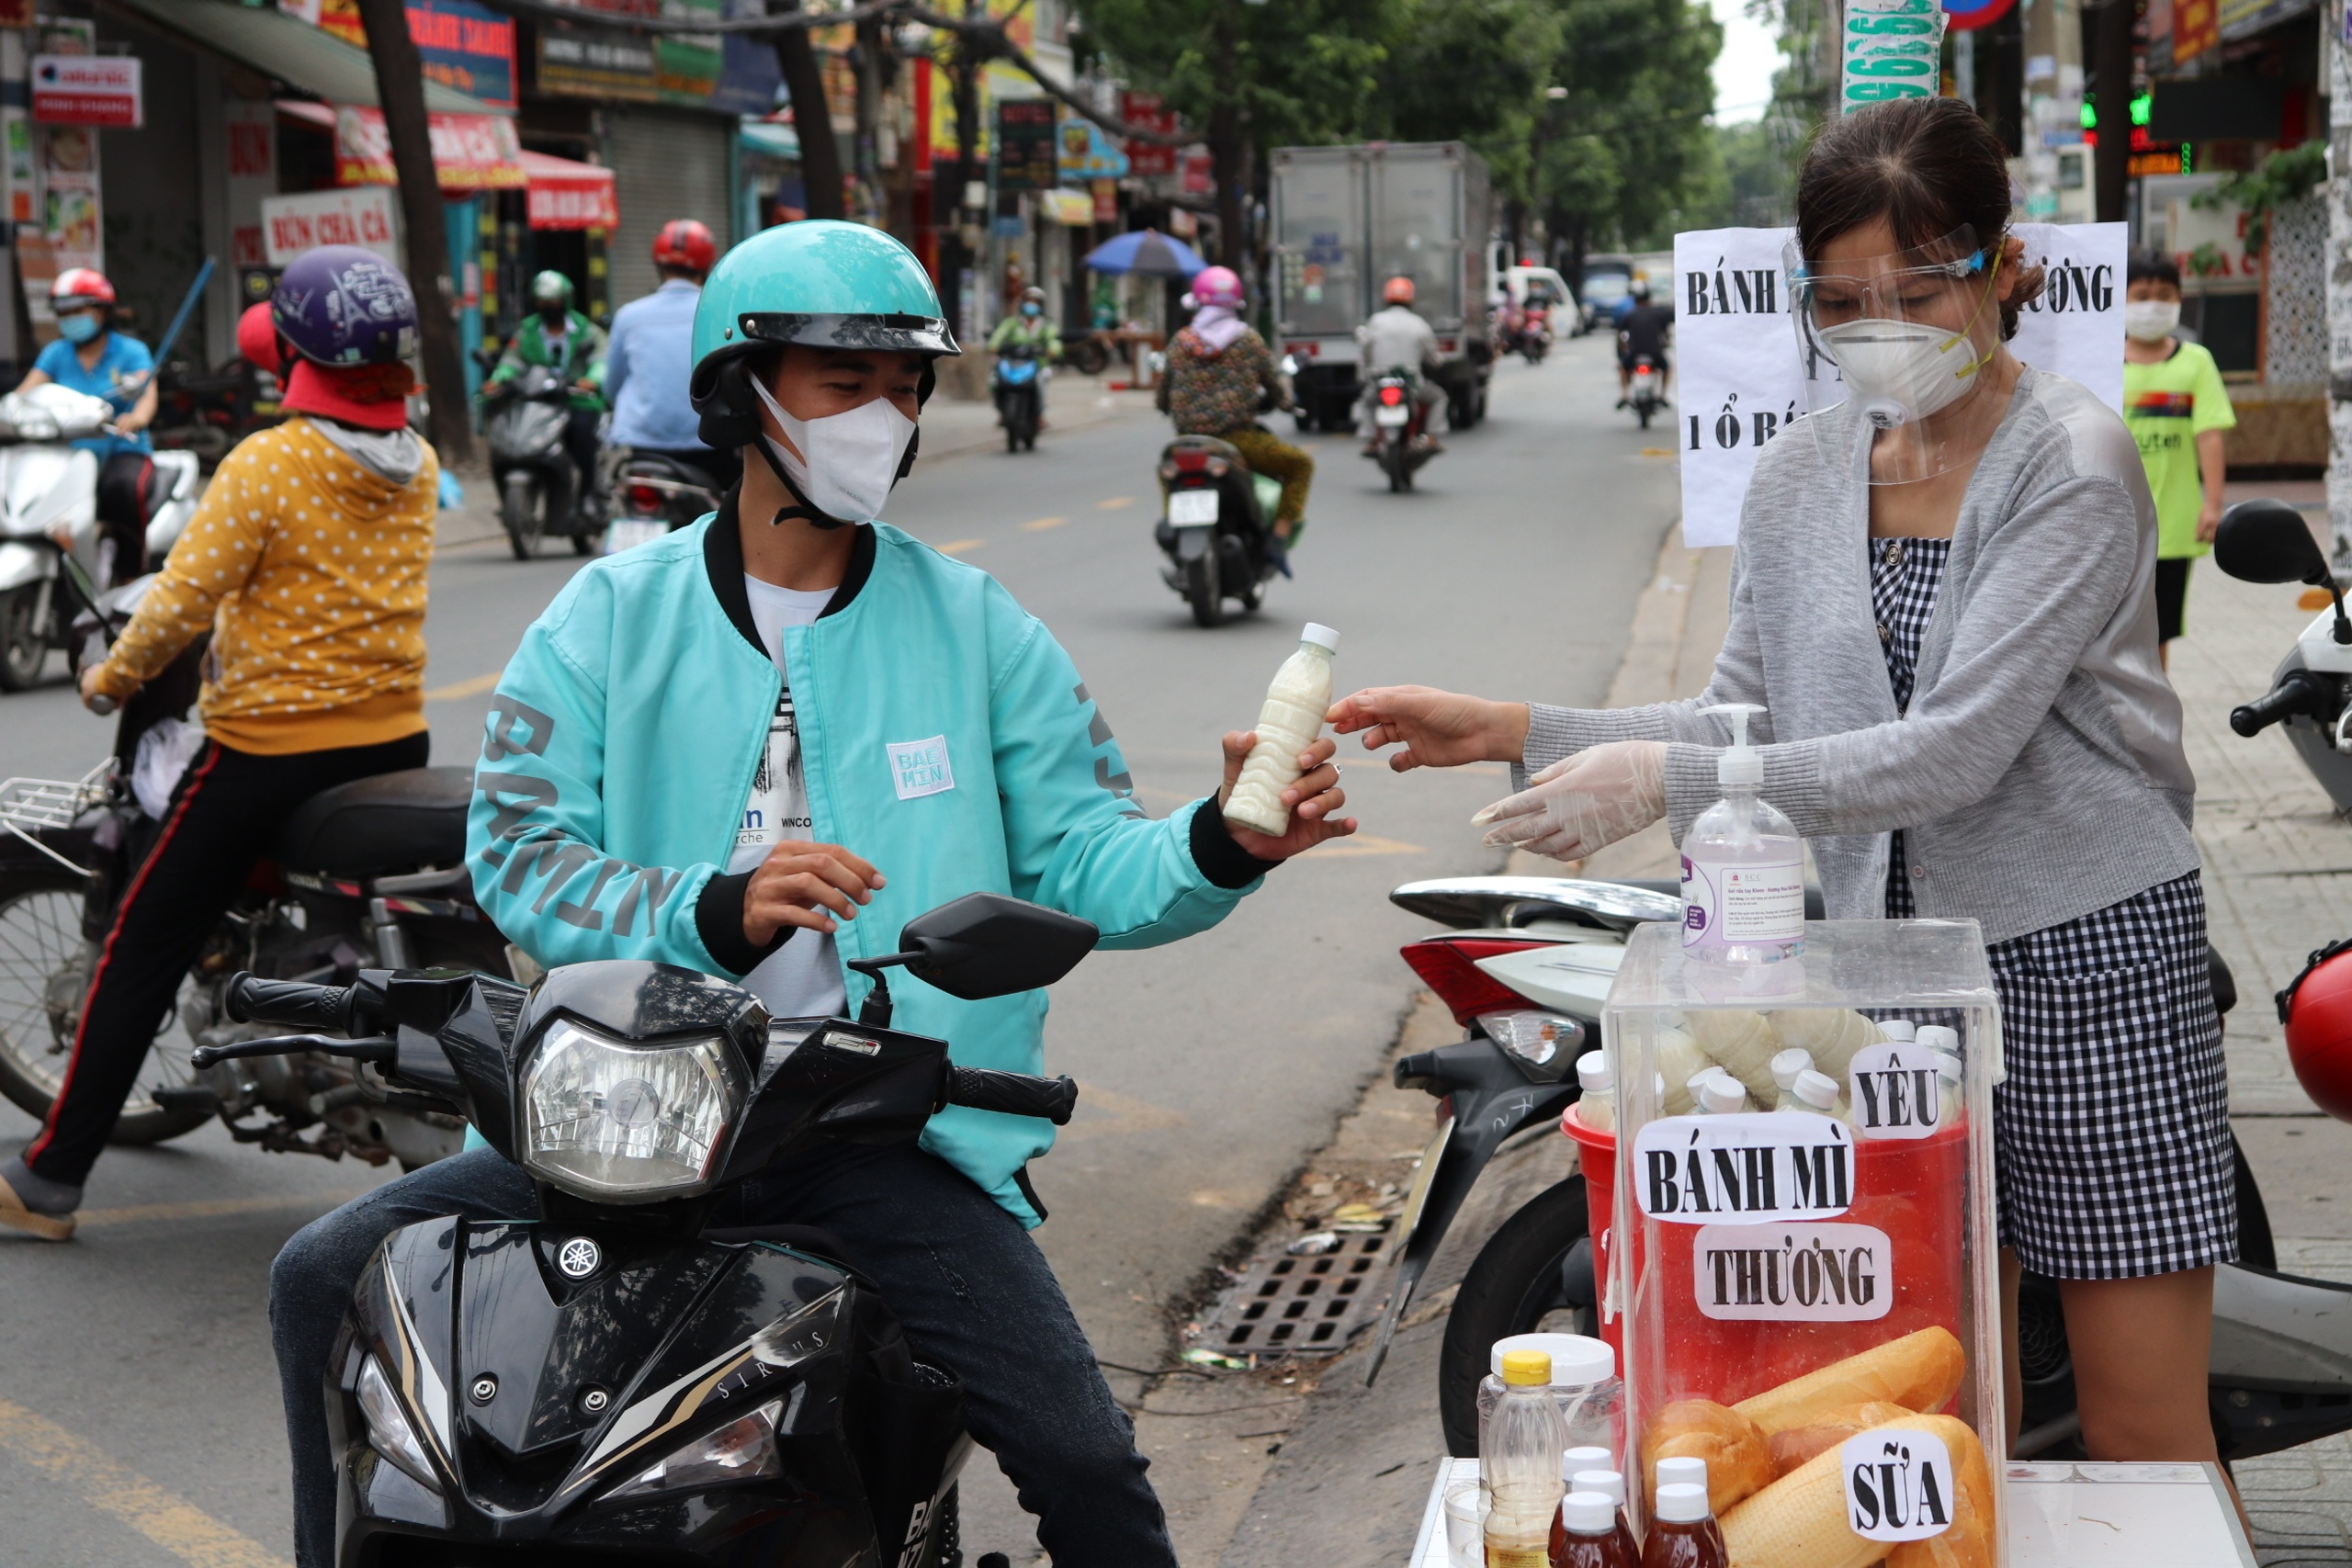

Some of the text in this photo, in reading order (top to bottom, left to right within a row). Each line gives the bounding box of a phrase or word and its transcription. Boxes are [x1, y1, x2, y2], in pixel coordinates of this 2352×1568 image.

[271, 206, 312, 252] BÚN
[316, 196, 357, 246] CHẢ
[361, 198, 390, 243] CÁ
[1686, 255, 1778, 315] BÁNH
[1688, 414, 1702, 450] 1
[1714, 392, 1741, 449] Ổ
[897, 747, 941, 770] BAE
[901, 764, 944, 788] MIN
[1856, 1053, 1939, 1129] YÊU
[1645, 1122, 1849, 1213] BÁNH MÌ
[1706, 1235, 1876, 1308] THƯƠNG
[717, 1331, 824, 1399] SIRUS
[1852, 1441, 1950, 1530] SỮA
